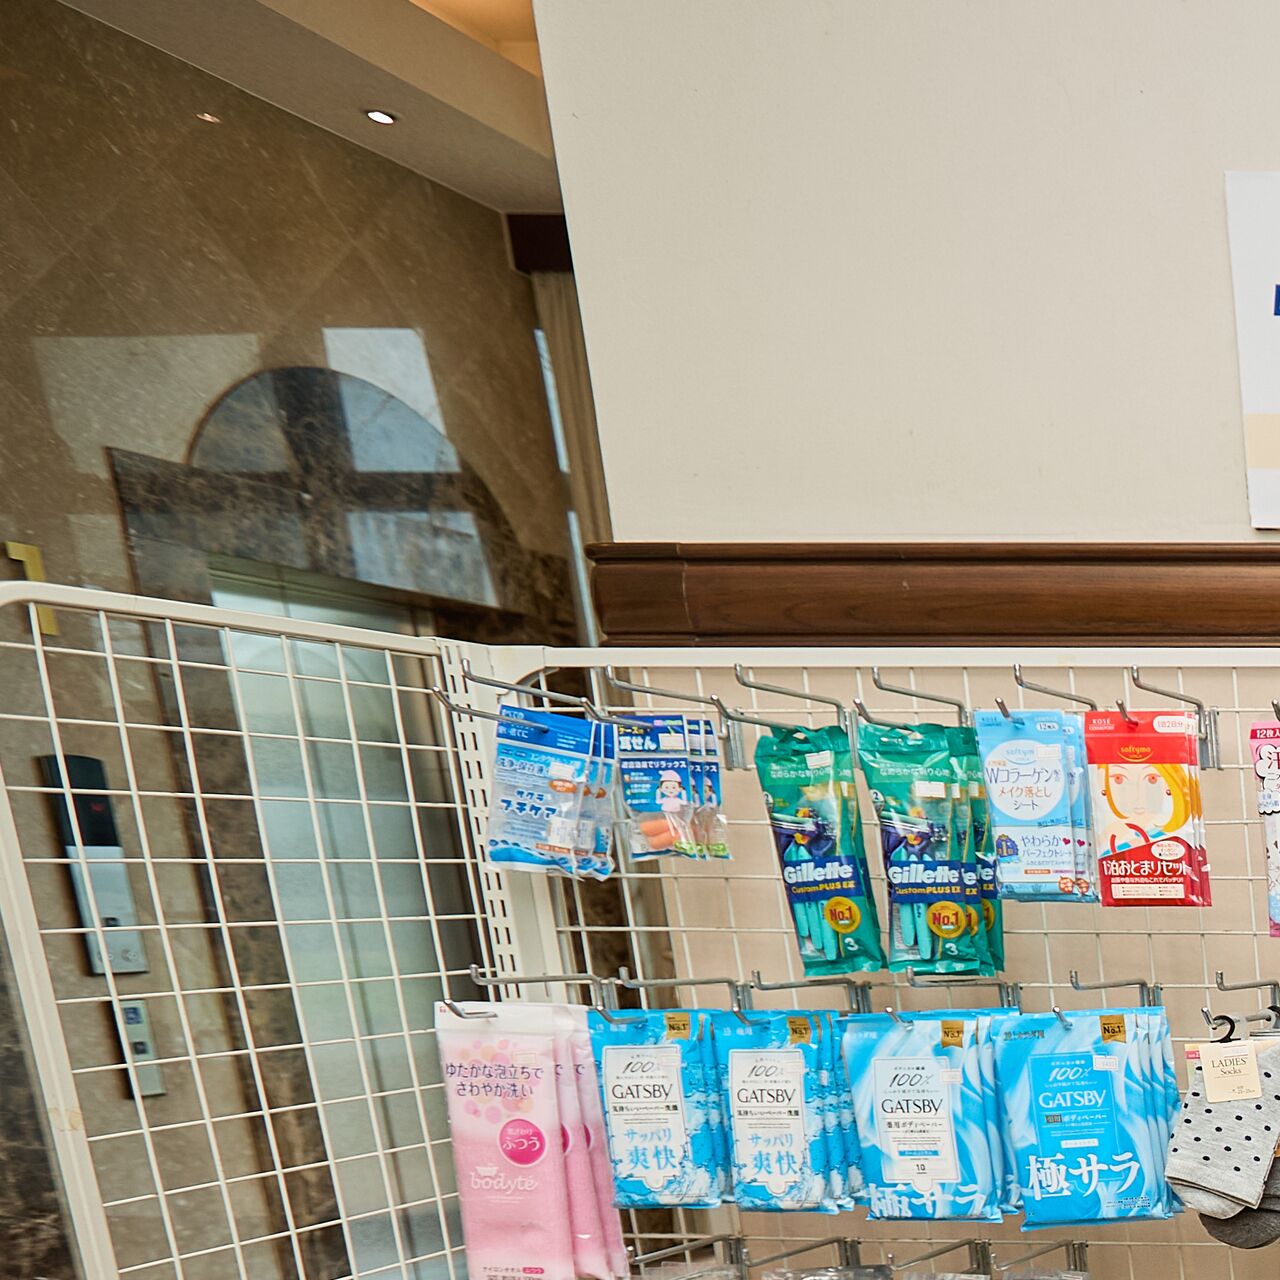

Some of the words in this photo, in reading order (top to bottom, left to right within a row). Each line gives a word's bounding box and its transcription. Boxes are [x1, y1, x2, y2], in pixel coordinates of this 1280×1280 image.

[1000, 785, 1052, 798] メイク落とし
[1013, 800, 1039, 810] シート
[1022, 836, 1061, 847] やわらか
[784, 864, 853, 883] Gillette
[888, 865, 959, 883] Gillette
[1104, 860, 1188, 876] 1泊おとまりセット
[830, 907, 851, 921] No.1
[933, 911, 958, 925] No.1
[1211, 1058, 1246, 1068] LADIES
[446, 1064, 543, 1080] ゆたかな泡立ちで
[1220, 1067, 1243, 1075] Socks
[456, 1082, 533, 1098] さわやか洗い
[612, 1084, 673, 1100] GATSBY
[737, 1088, 797, 1104] GATSBY
[881, 1099, 943, 1114] GATSBY
[1038, 1091, 1106, 1109] GATSBY
[623, 1128, 672, 1142] サッパリ
[751, 1133, 793, 1147] サッパリ
[503, 1136, 541, 1150] ふつう
[627, 1147, 677, 1171] 爽快
[753, 1153, 799, 1175] 爽快
[1026, 1152, 1140, 1200] 極サラ
